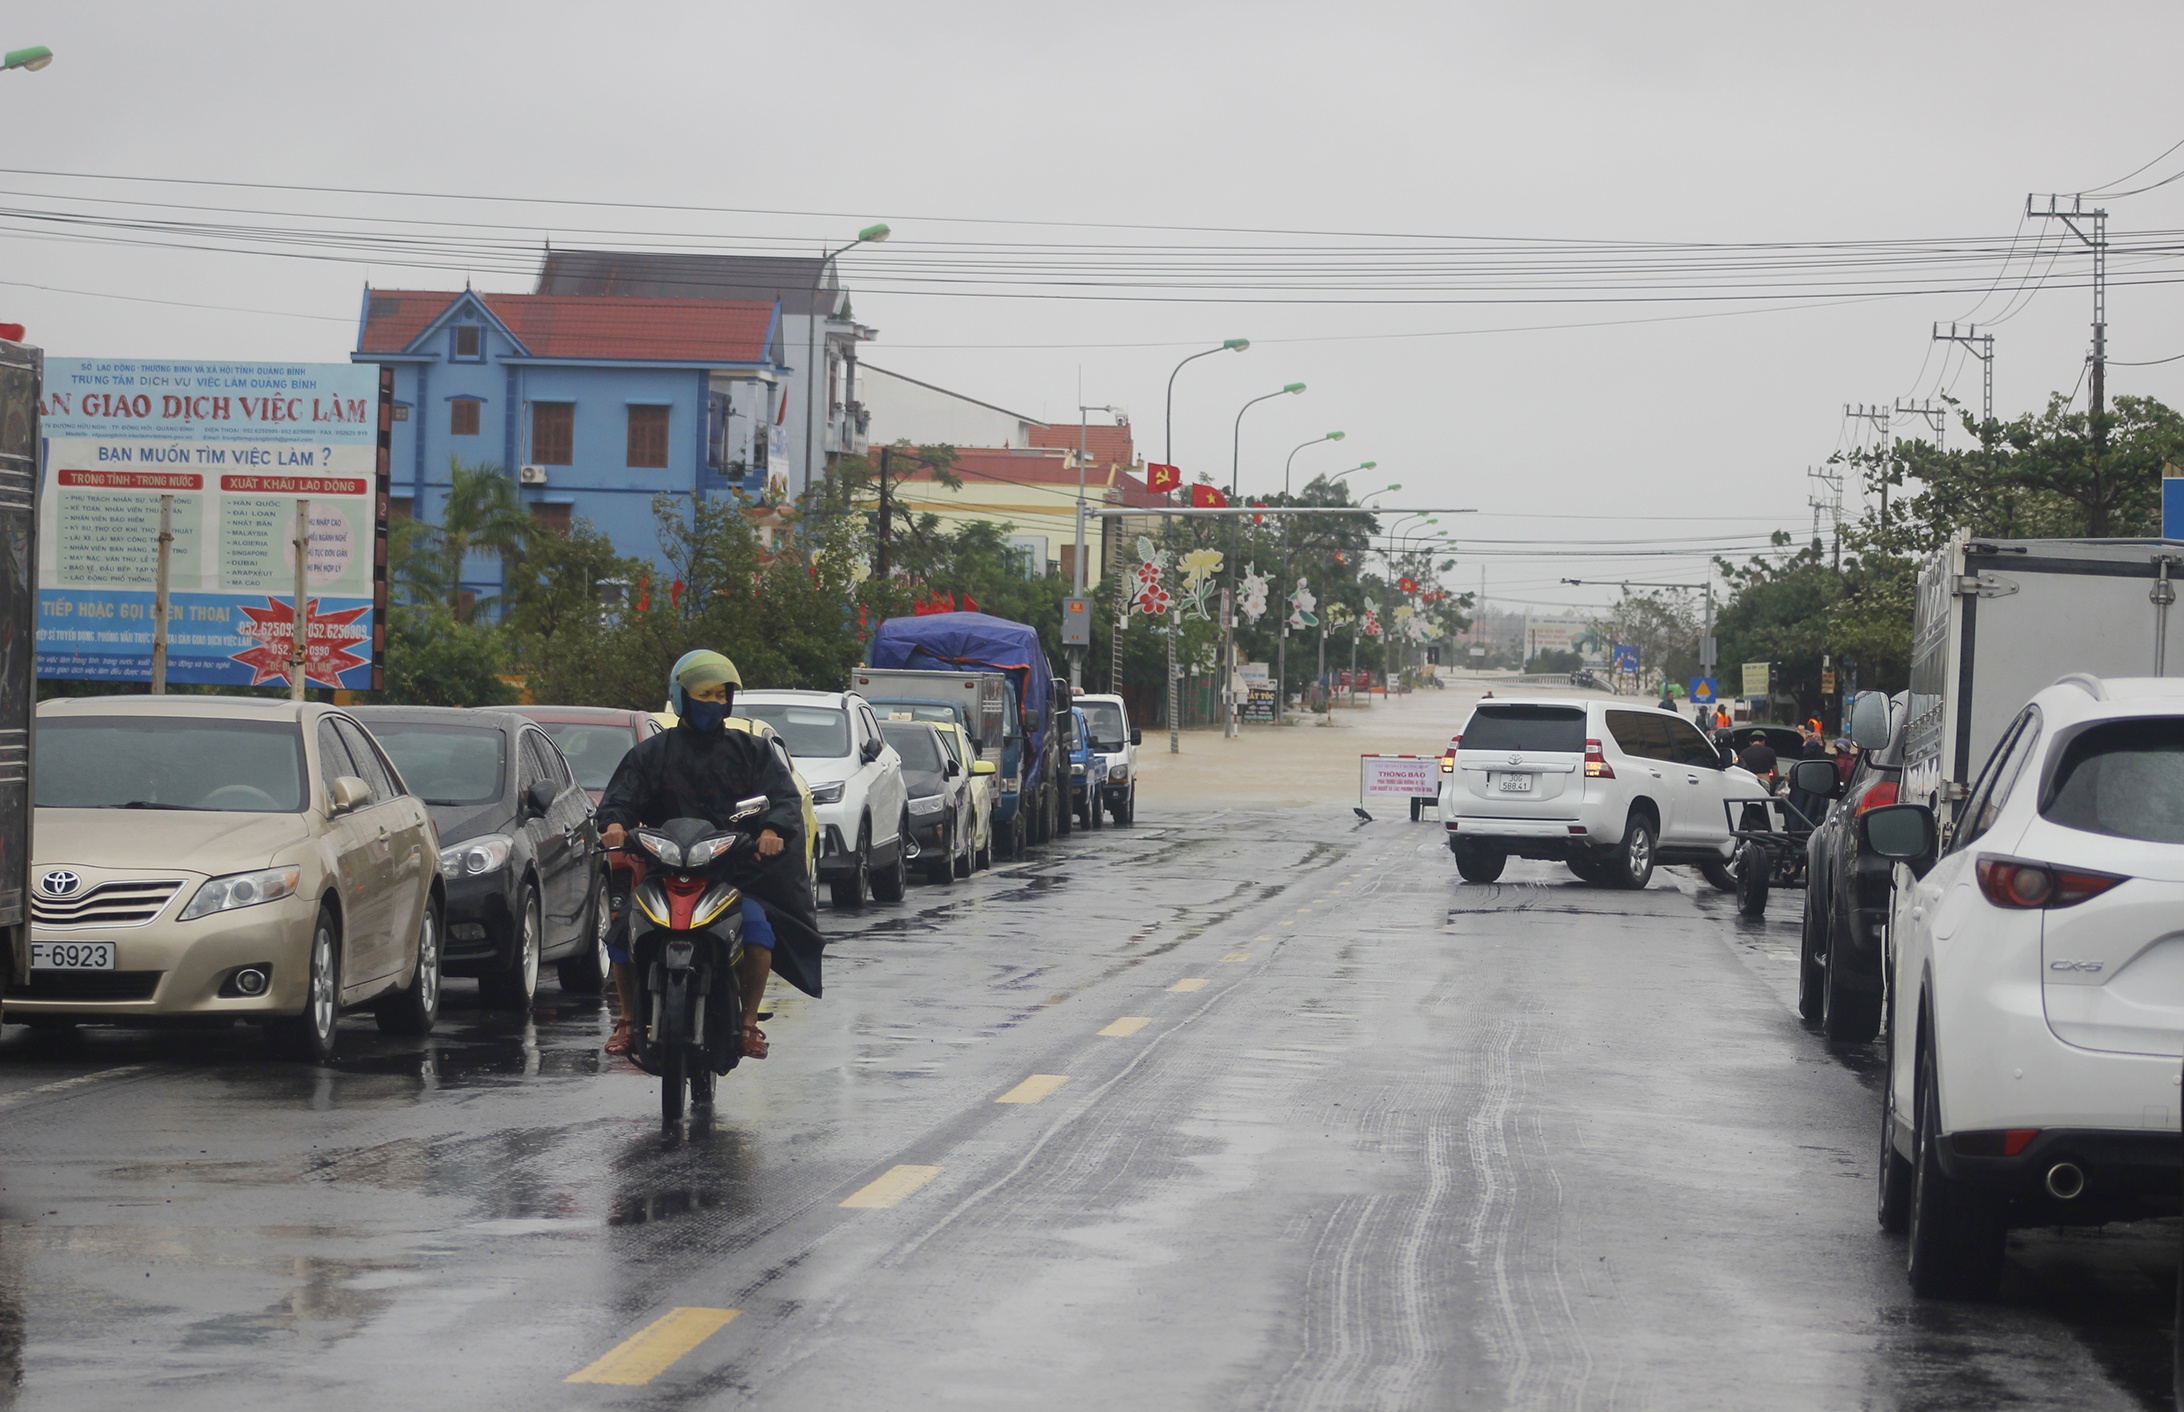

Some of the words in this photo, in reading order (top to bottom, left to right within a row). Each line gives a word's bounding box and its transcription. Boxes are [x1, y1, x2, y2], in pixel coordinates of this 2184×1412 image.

[97, 364, 111, 372] LAO
[72, 375, 110, 385] TRUNG
[82, 393, 152, 418] GIAO
[162, 395, 231, 424] DỊCH
[238, 391, 304, 425] VIỆC
[313, 392, 368, 424] LÀM
[99, 446, 133, 464] BẠN
[140, 442, 190, 464] MUỐN
[196, 444, 226, 464] TÌM
[231, 446, 271, 468] VIỆC
[278, 446, 314, 466] LÀM
[322, 446, 332, 467] ?
[71, 473, 105, 485] TRONG
[136, 474, 167, 486] TRONG
[169, 474, 194, 487] NƯỚC
[300, 480, 321, 490] LAO
[324, 479, 356, 493] ĐỘNG
[42, 597, 73, 617] TIẾP
[79, 600, 115, 620] HOẶC
[120, 603, 144, 621] GỌI
[189, 605, 230, 624] THOẠI
[1378, 770, 1407, 778] THÔNG
[1503, 782, 1527, 790] 588.41
[31, 945, 107, 967] F-6923
[2050, 959, 2103, 972] CX-5
